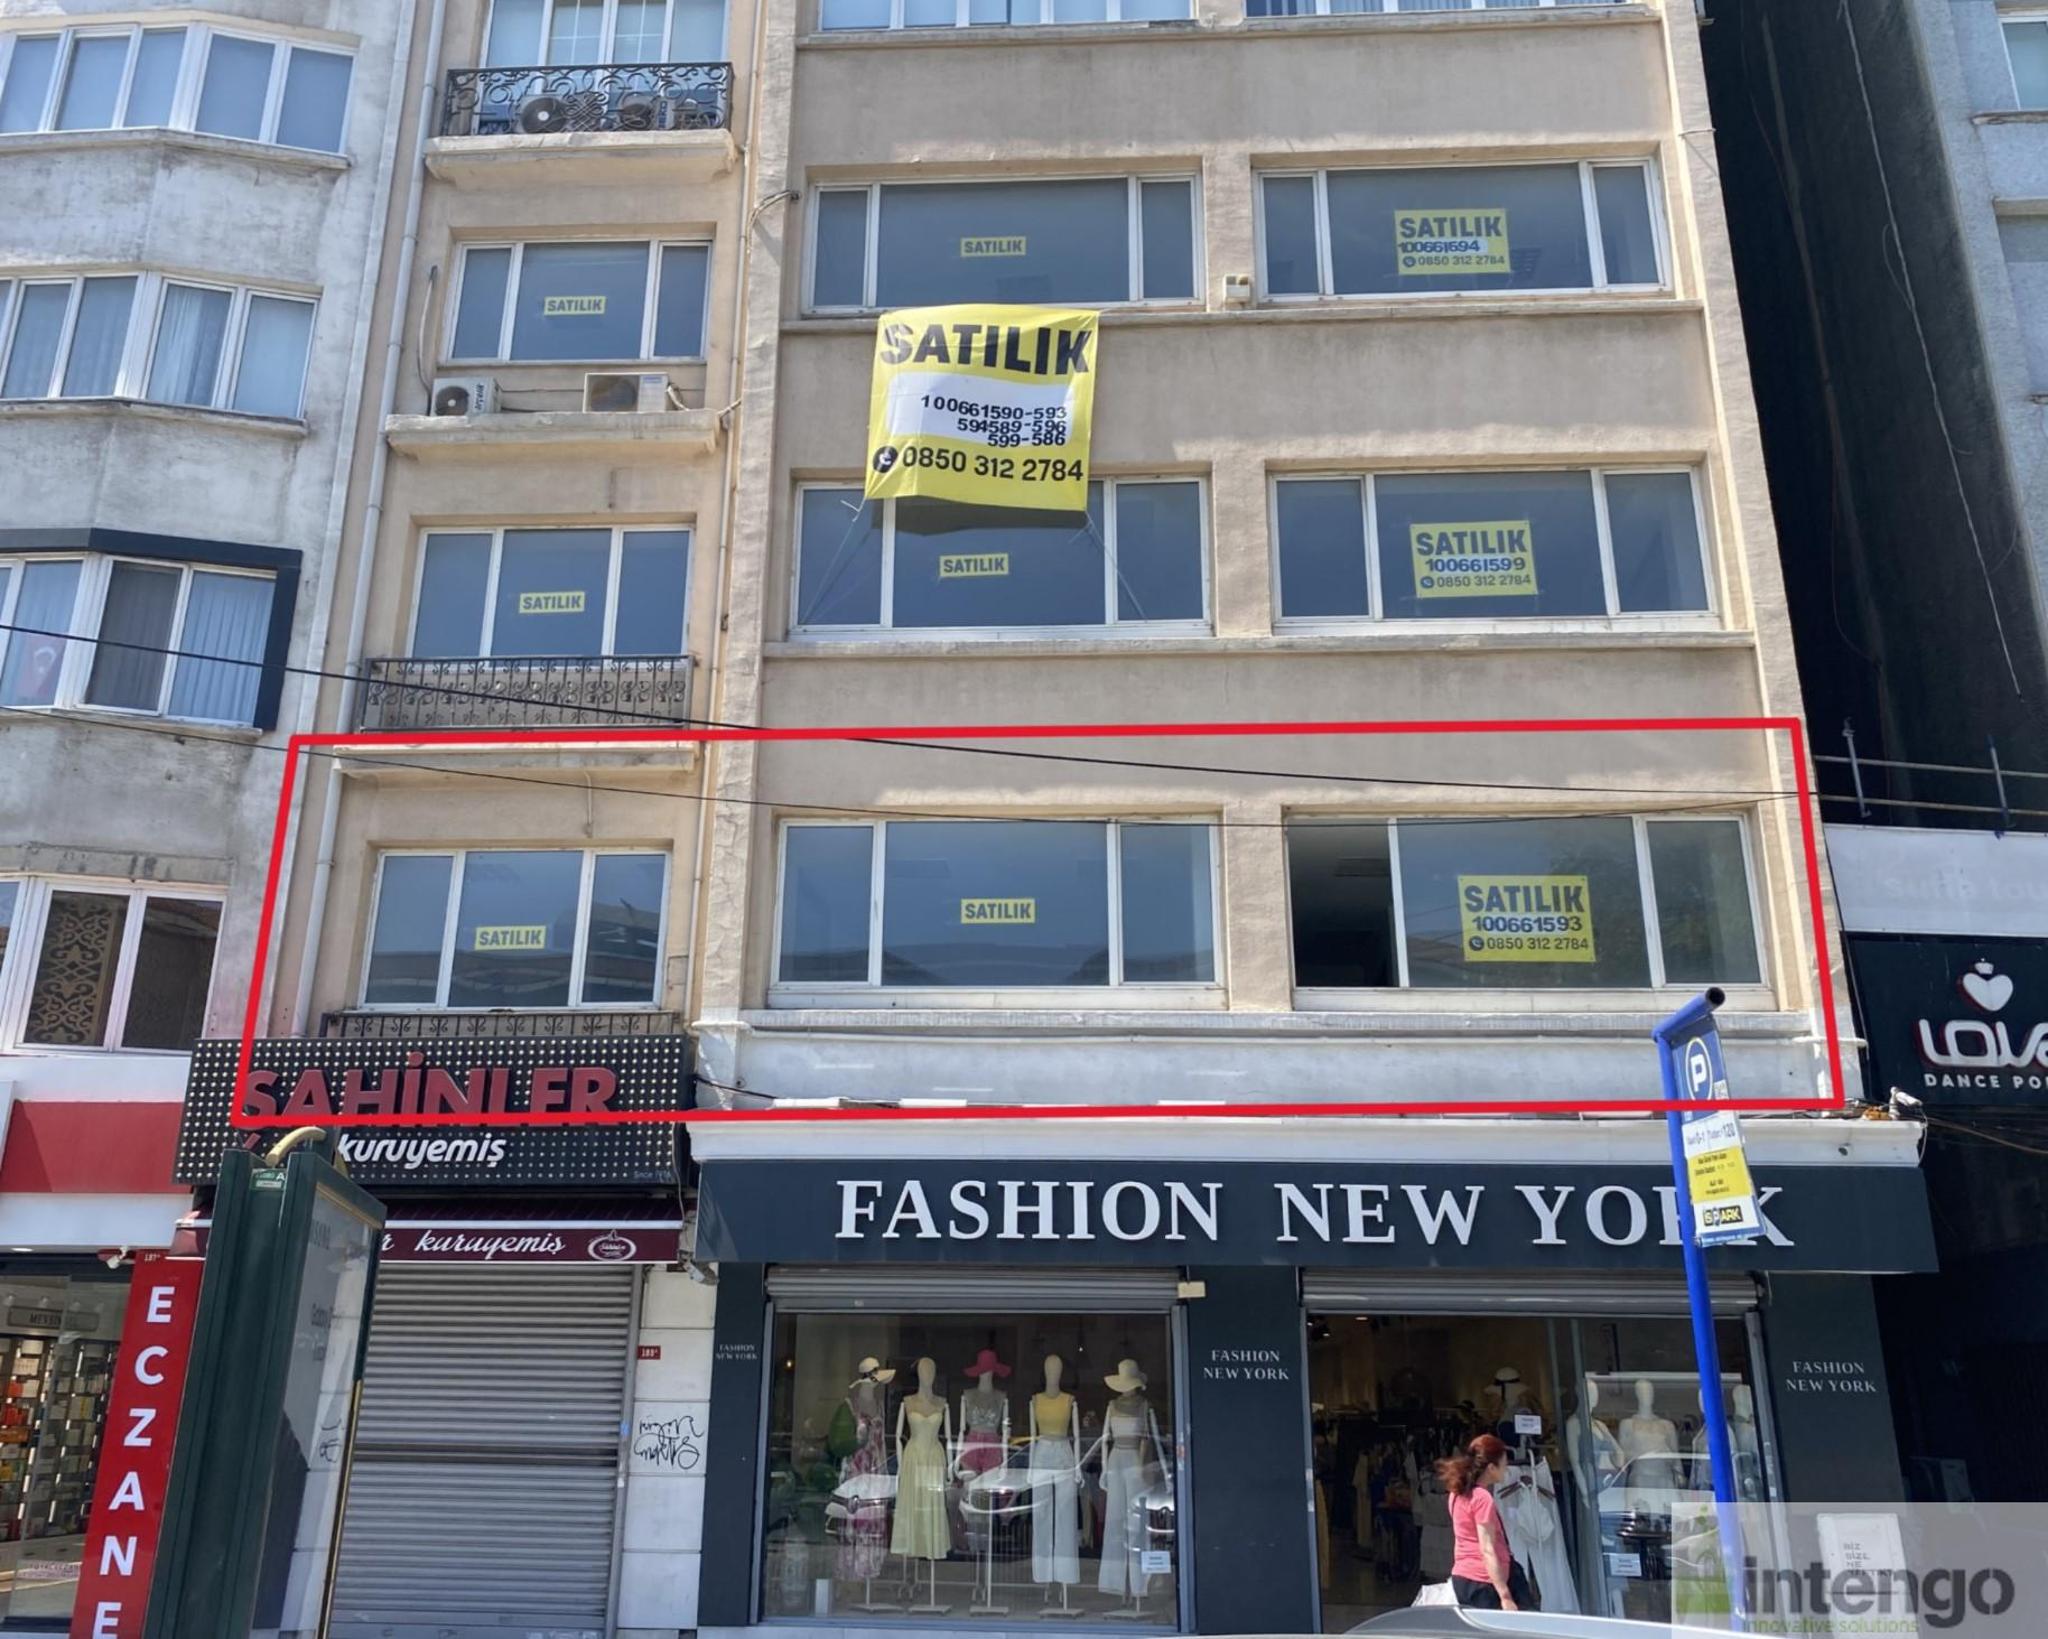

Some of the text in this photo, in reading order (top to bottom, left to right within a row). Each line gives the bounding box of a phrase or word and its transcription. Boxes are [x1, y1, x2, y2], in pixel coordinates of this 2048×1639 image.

[1400, 216, 1502, 238] SATILIK
[964, 239, 1023, 253] SATILIK
[1418, 254, 1505, 266] 0850 312 2784
[547, 299, 602, 312] SATILIK
[879, 323, 1092, 375] SATILIK
[903, 446, 1084, 482] 0850 312 2784
[1416, 529, 1527, 556] SATILIK
[944, 557, 1005, 573] SATILIK
[1425, 557, 1526, 572] 100661599
[1436, 574, 1531, 587] 0850 312 2784
[523, 595, 582, 610] SATILIK
[1464, 885, 1585, 913] SATILIK
[965, 903, 1031, 919] SATILIK
[1472, 916, 1583, 933] 100661593
[480, 930, 542, 946] SATILIK
[1487, 937, 1589, 950] 0850 312 2784
[1690, 1053, 1707, 1093] P
[1924, 1073, 2048, 1089] DANCE PO
[337, 1132, 507, 1169] kuruyemiş
[835, 1180, 1795, 1247] FASHION NEW YOK
[415, 1230, 566, 1260] kuruyemiş
[1212, 1350, 1280, 1361] FASHION
[1203, 1367, 1289, 1379] NEW YORK
[1793, 1361, 1864, 1374] FASHION
[1786, 1379, 1876, 1392] NEW YORK
[93, 1286, 175, 1639] ECZANE
